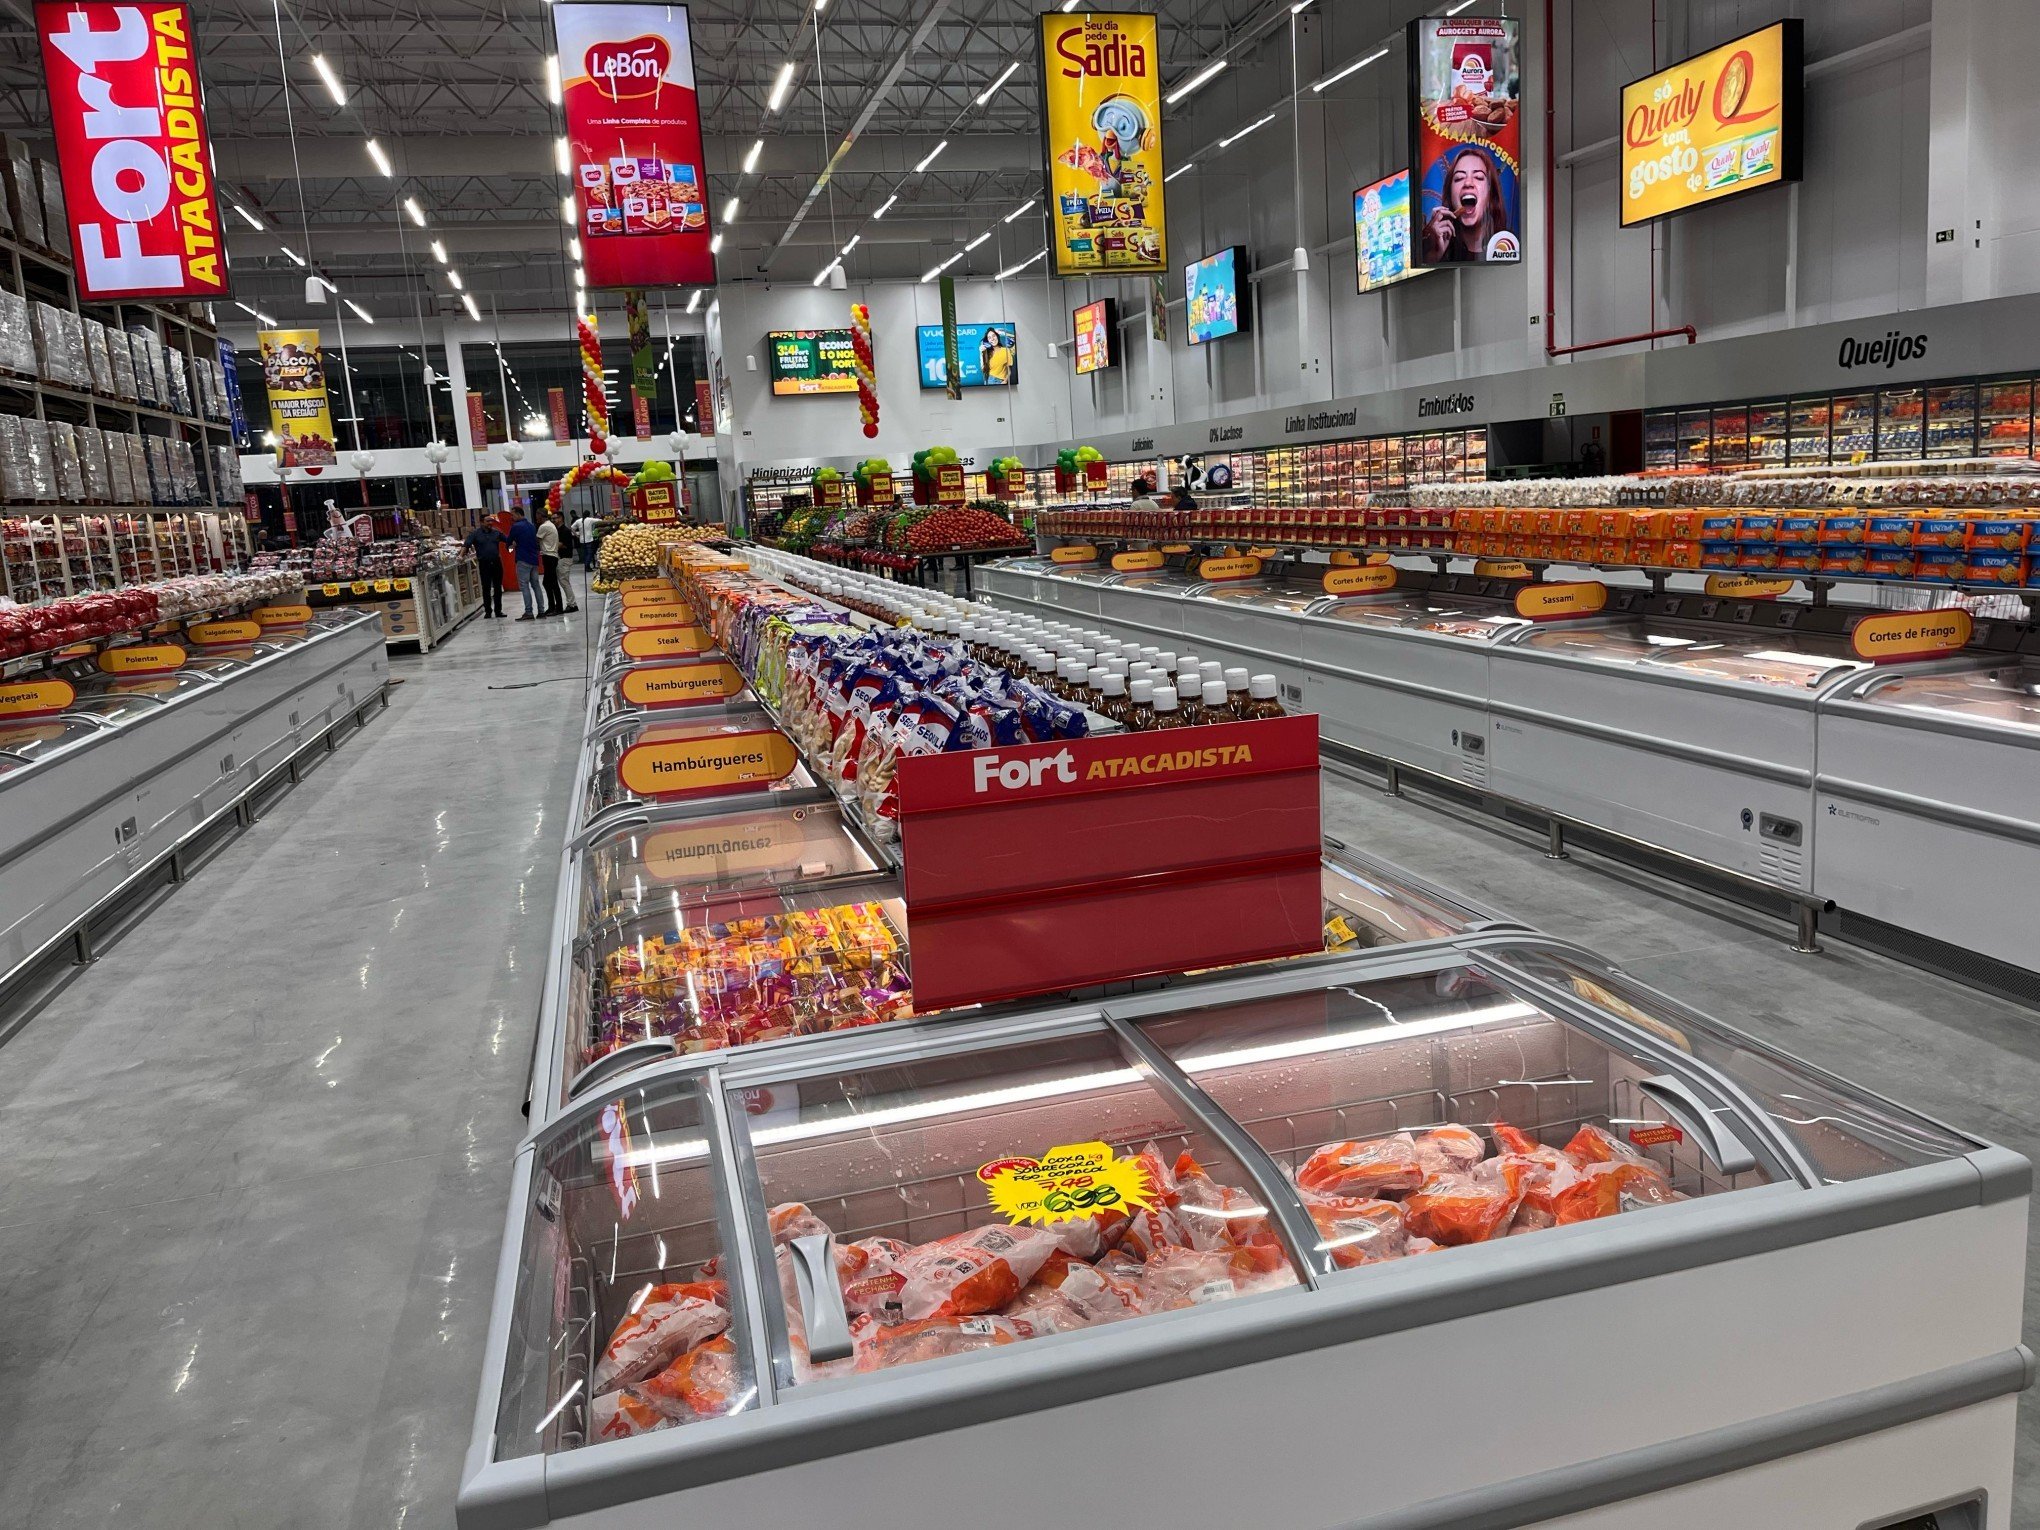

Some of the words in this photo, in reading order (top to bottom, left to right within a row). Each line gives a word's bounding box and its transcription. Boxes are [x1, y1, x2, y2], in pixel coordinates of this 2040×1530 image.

[1084, 21, 1103, 31] Seu
[1104, 21, 1118, 31] dia
[1085, 32, 1108, 41] pede
[1056, 27, 1146, 79] Sadia
[593, 47, 658, 77] LeBon
[1654, 79, 1672, 103] só
[1626, 78, 1705, 150] Qualy
[621, 118, 651, 126] Completa
[661, 118, 687, 126] produtos
[1661, 128, 1691, 147] tem
[49, 7, 184, 291] Fort
[152, 8, 221, 287] ATACADISTA
[1629, 147, 1699, 200] gosto
[1686, 173, 1703, 192] de
[1492, 250, 1517, 259] Aurora
[1838, 331, 1928, 369] Queijos
[1418, 393, 1475, 418] Embutidos
[1285, 416, 1306, 434] Linha
[1307, 408, 1357, 431] Institucional
[1209, 429, 1219, 443] 0%
[1219, 426, 1243, 442] Lactose
[752, 466, 821, 482] Higienizado
[1208, 564, 1226, 572] Cortes
[1226, 563, 1234, 571] de
[1234, 562, 1254, 571] Frango
[1497, 563, 1522, 572] Frangos
[1333, 576, 1354, 586] Cortes
[1355, 575, 1364, 584] de
[1364, 574, 1388, 585] Frango
[1718, 579, 1742, 589] Cortes
[1542, 593, 1574, 605] Sassami
[204, 628, 243, 638] Salgadinhos
[657, 636, 680, 645] Steak
[1869, 629, 1902, 643] Cortes
[1904, 627, 1918, 640] de
[1920, 625, 1957, 641] Frango
[125, 655, 159, 664] Polentas
[646, 676, 723, 692] Hambúrgueres
[652, 751, 764, 774] Hambúrgueres
[973, 747, 1078, 793] Fort
[1085, 744, 1253, 781] ATACADISTA
[1633, 1126, 1675, 1141] MANTENHA
[1639, 1134, 1676, 1146] FECHADO
[1047, 1155, 1085, 1164] COXA
[1014, 1161, 1095, 1175] SOBRECOXA
[1048, 1166, 1108, 1178] COPACOL
[854, 1283, 896, 1296] FECHADO
